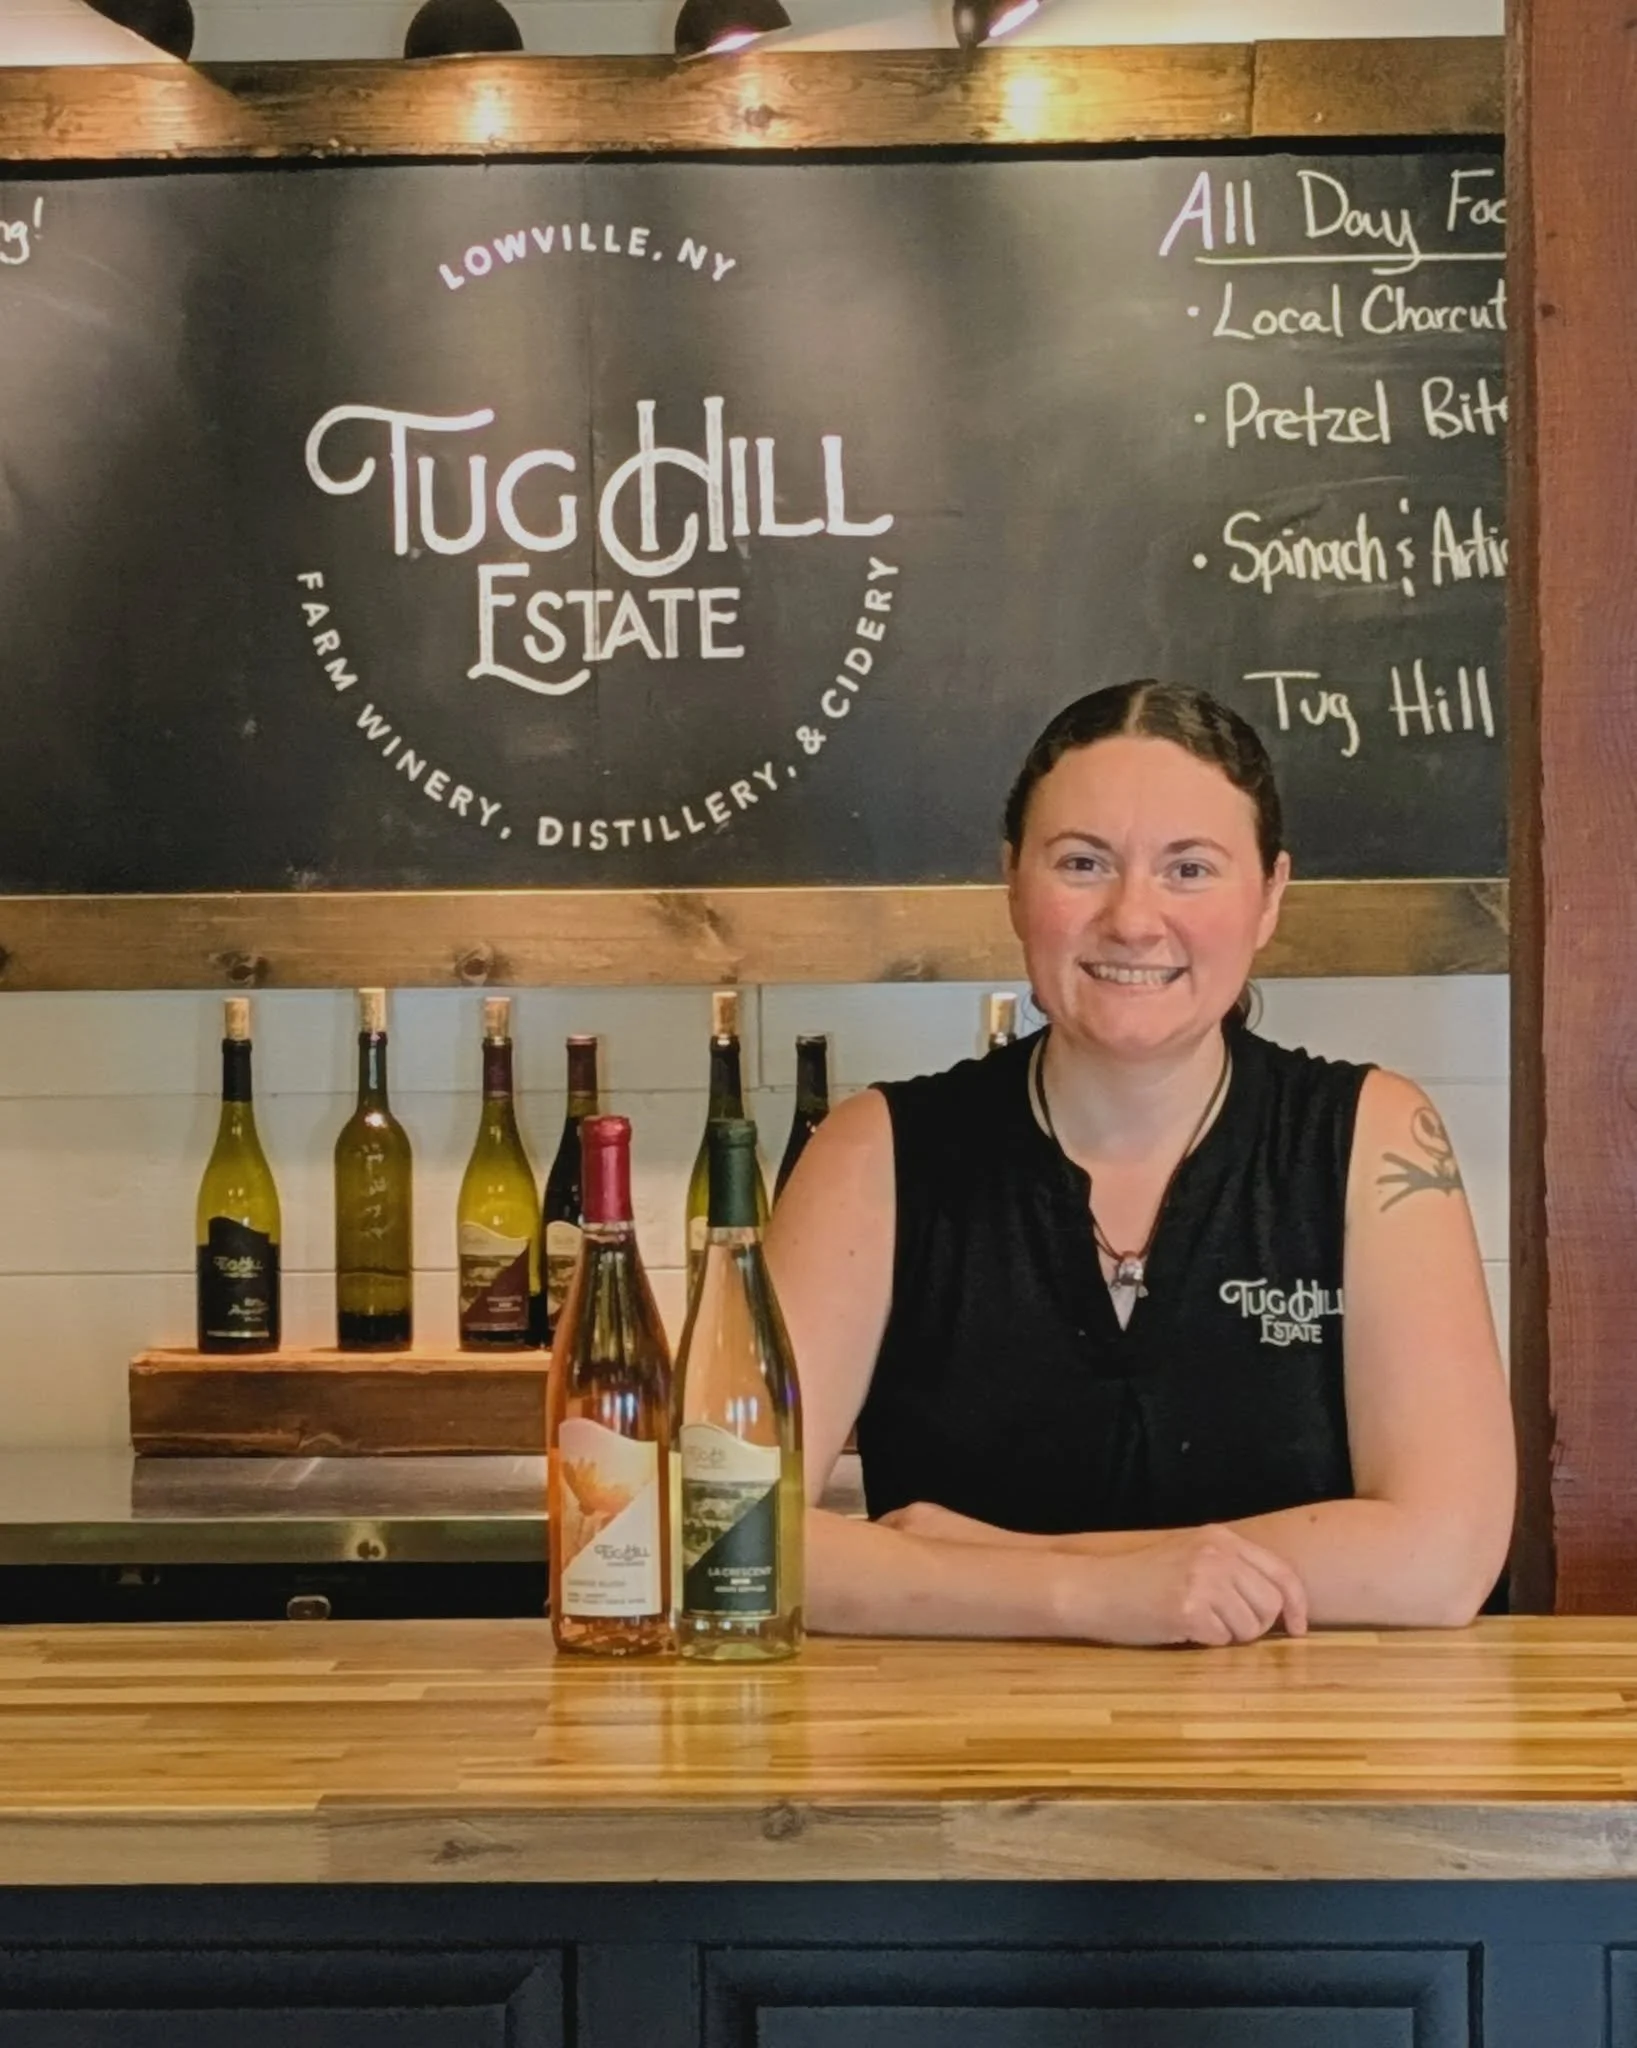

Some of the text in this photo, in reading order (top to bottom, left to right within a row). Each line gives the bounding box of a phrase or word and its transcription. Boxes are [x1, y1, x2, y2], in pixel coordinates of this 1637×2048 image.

[439, 223, 736, 290] LOWVILLE, NY
[1159, 171, 1255, 256] All
[1297, 170, 1421, 275] Day
[1213, 279, 1508, 340] Local Charcut
[1226, 379, 1391, 448] Pretzel
[305, 396, 893, 577] TUG HILL
[1223, 511, 1388, 594] Spinach
[468, 563, 745, 695] ESTATE
[297, 556, 899, 850] FARM WINERY, DISTILLERY, & CIDERY
[1243, 658, 1495, 758] Tug Hill
[1219, 1278, 1344, 1323] TUG HILL
[1260, 1314, 1323, 1347] ESTATE
